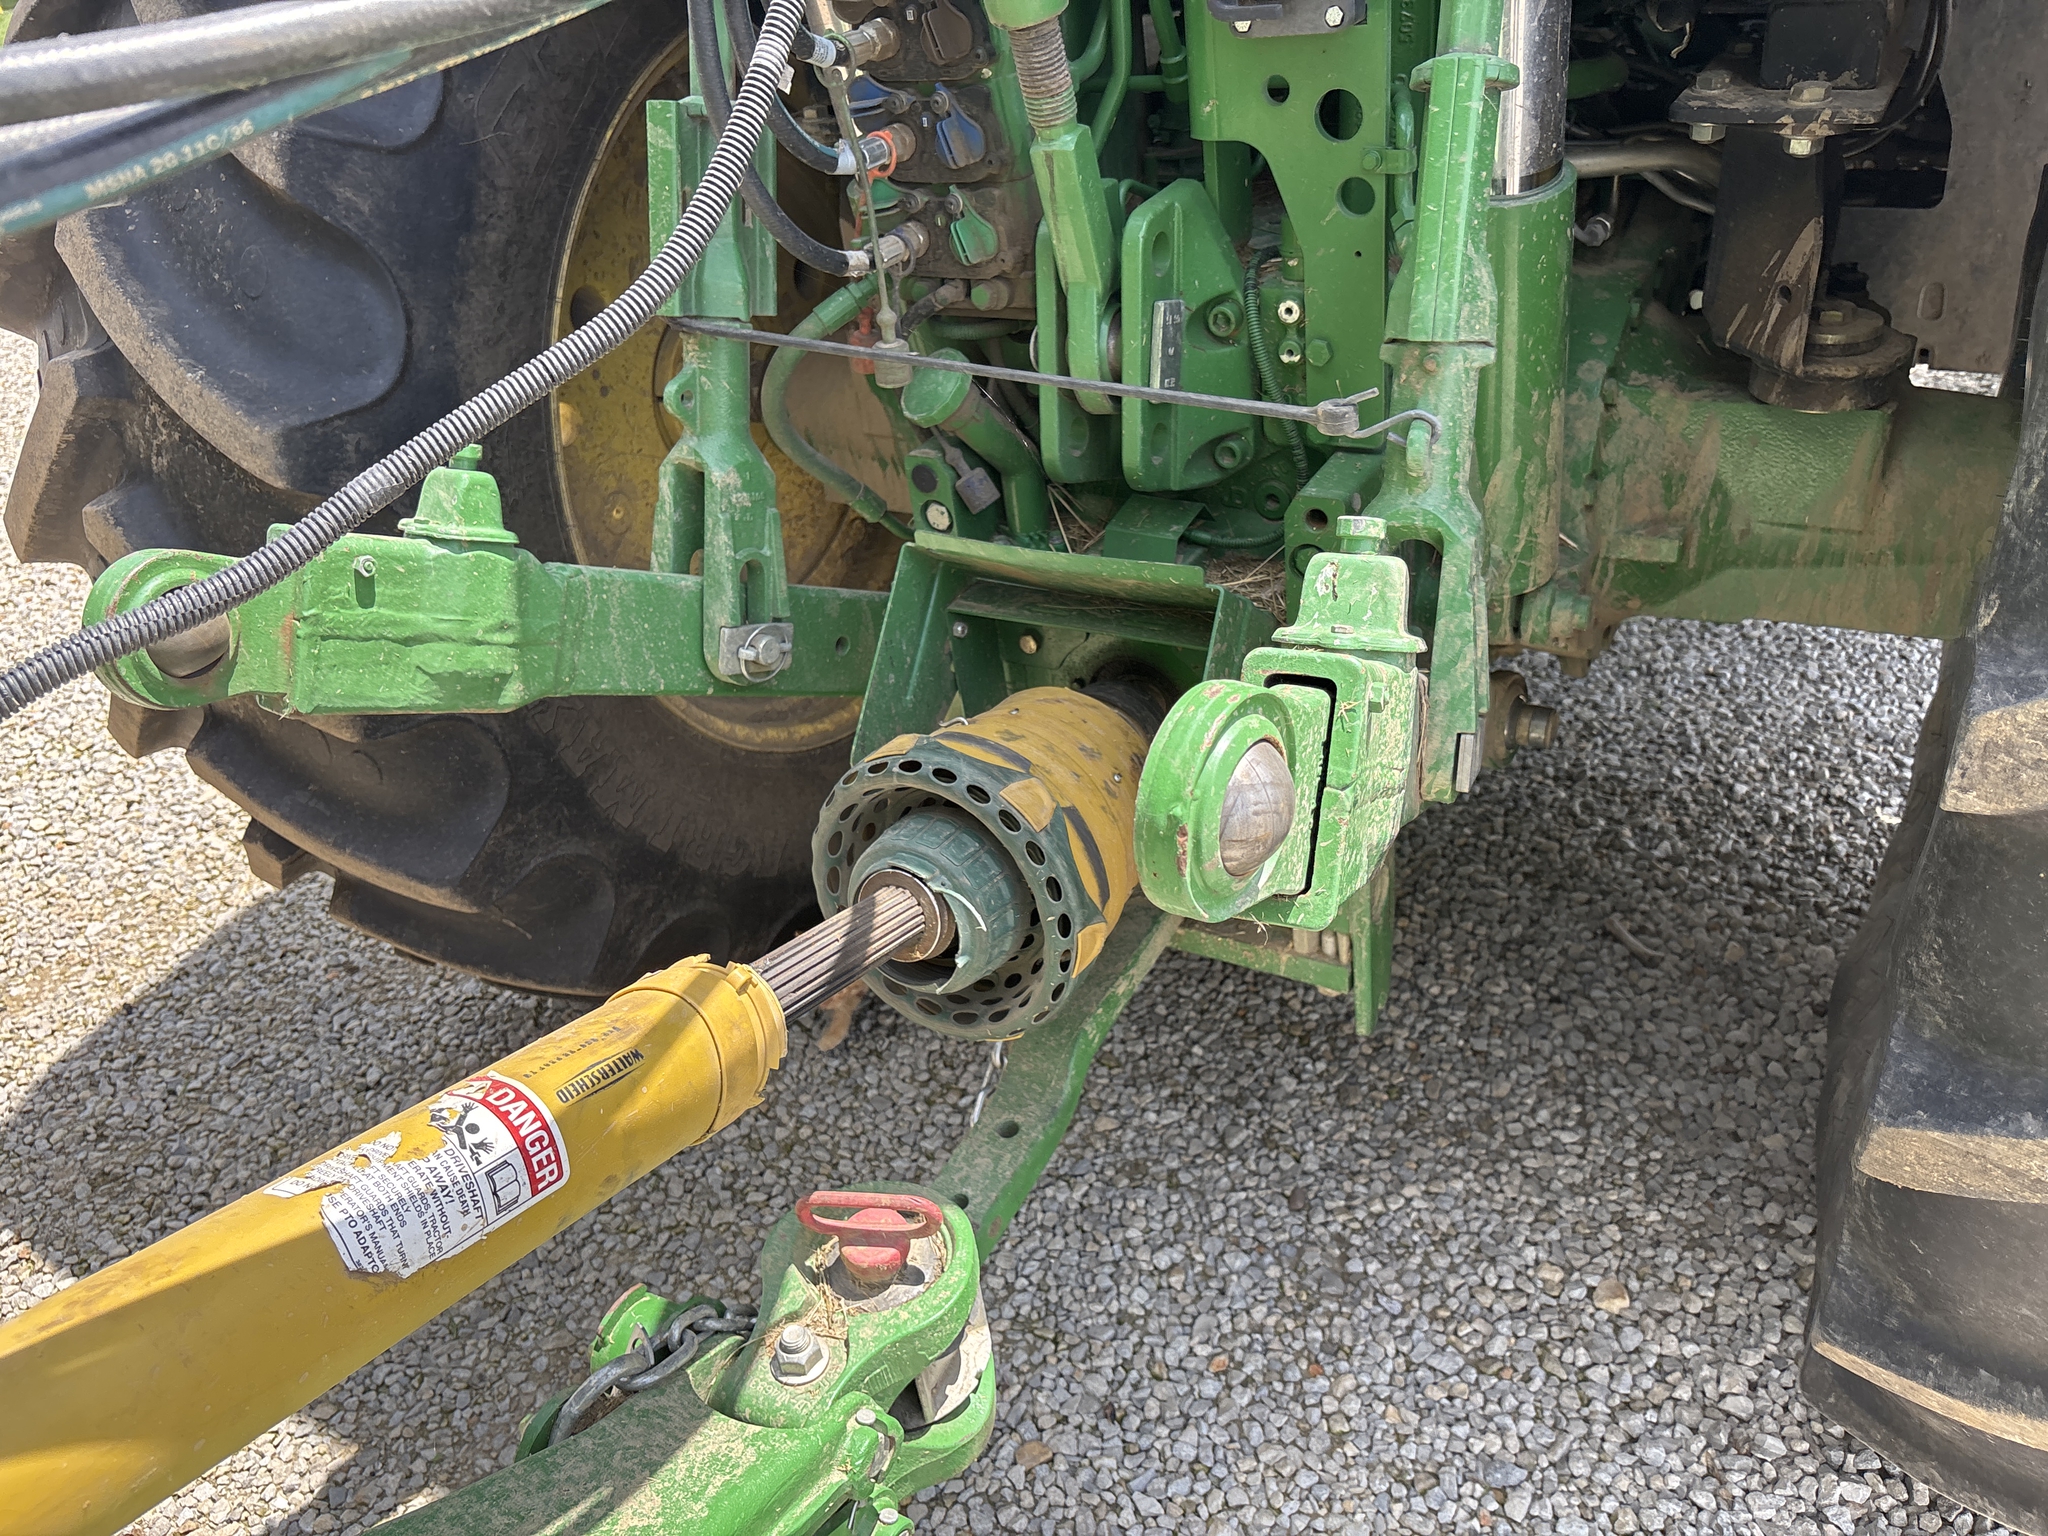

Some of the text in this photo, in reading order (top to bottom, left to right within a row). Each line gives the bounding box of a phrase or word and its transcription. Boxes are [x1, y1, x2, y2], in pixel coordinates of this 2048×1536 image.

[555, 1048, 645, 1104] WALTERSCHEID
[487, 1087, 563, 1192] DANGER
[362, 1169, 374, 1181] AT
[372, 1180, 394, 1204] BOTH
[390, 1203, 407, 1228] ENDS
[378, 1175, 412, 1214] SECURELY
[401, 1180, 425, 1219] SHIELDS
[407, 1160, 434, 1191] ERATE
[425, 1165, 455, 1205] AWAY!
[440, 1160, 460, 1190] CAUSE
[455, 1187, 470, 1217] DEATH
[444, 1148, 483, 1220] DRIVESHAFT
[340, 1189, 373, 1231] PERATOR'S
[347, 1184, 386, 1231] DRIVESHAFT
[361, 1183, 389, 1217] GUARDS
[384, 1215, 401, 1240] THAT
[407, 1175, 431, 1214] GUARDS,
[428, 1213, 444, 1255] TRACTOR
[420, 1219, 429, 1230] IN
[339, 1210, 358, 1229] PTO
[353, 1230, 380, 1273] ADAPTO
[424, 1230, 436, 1260] PLACE
